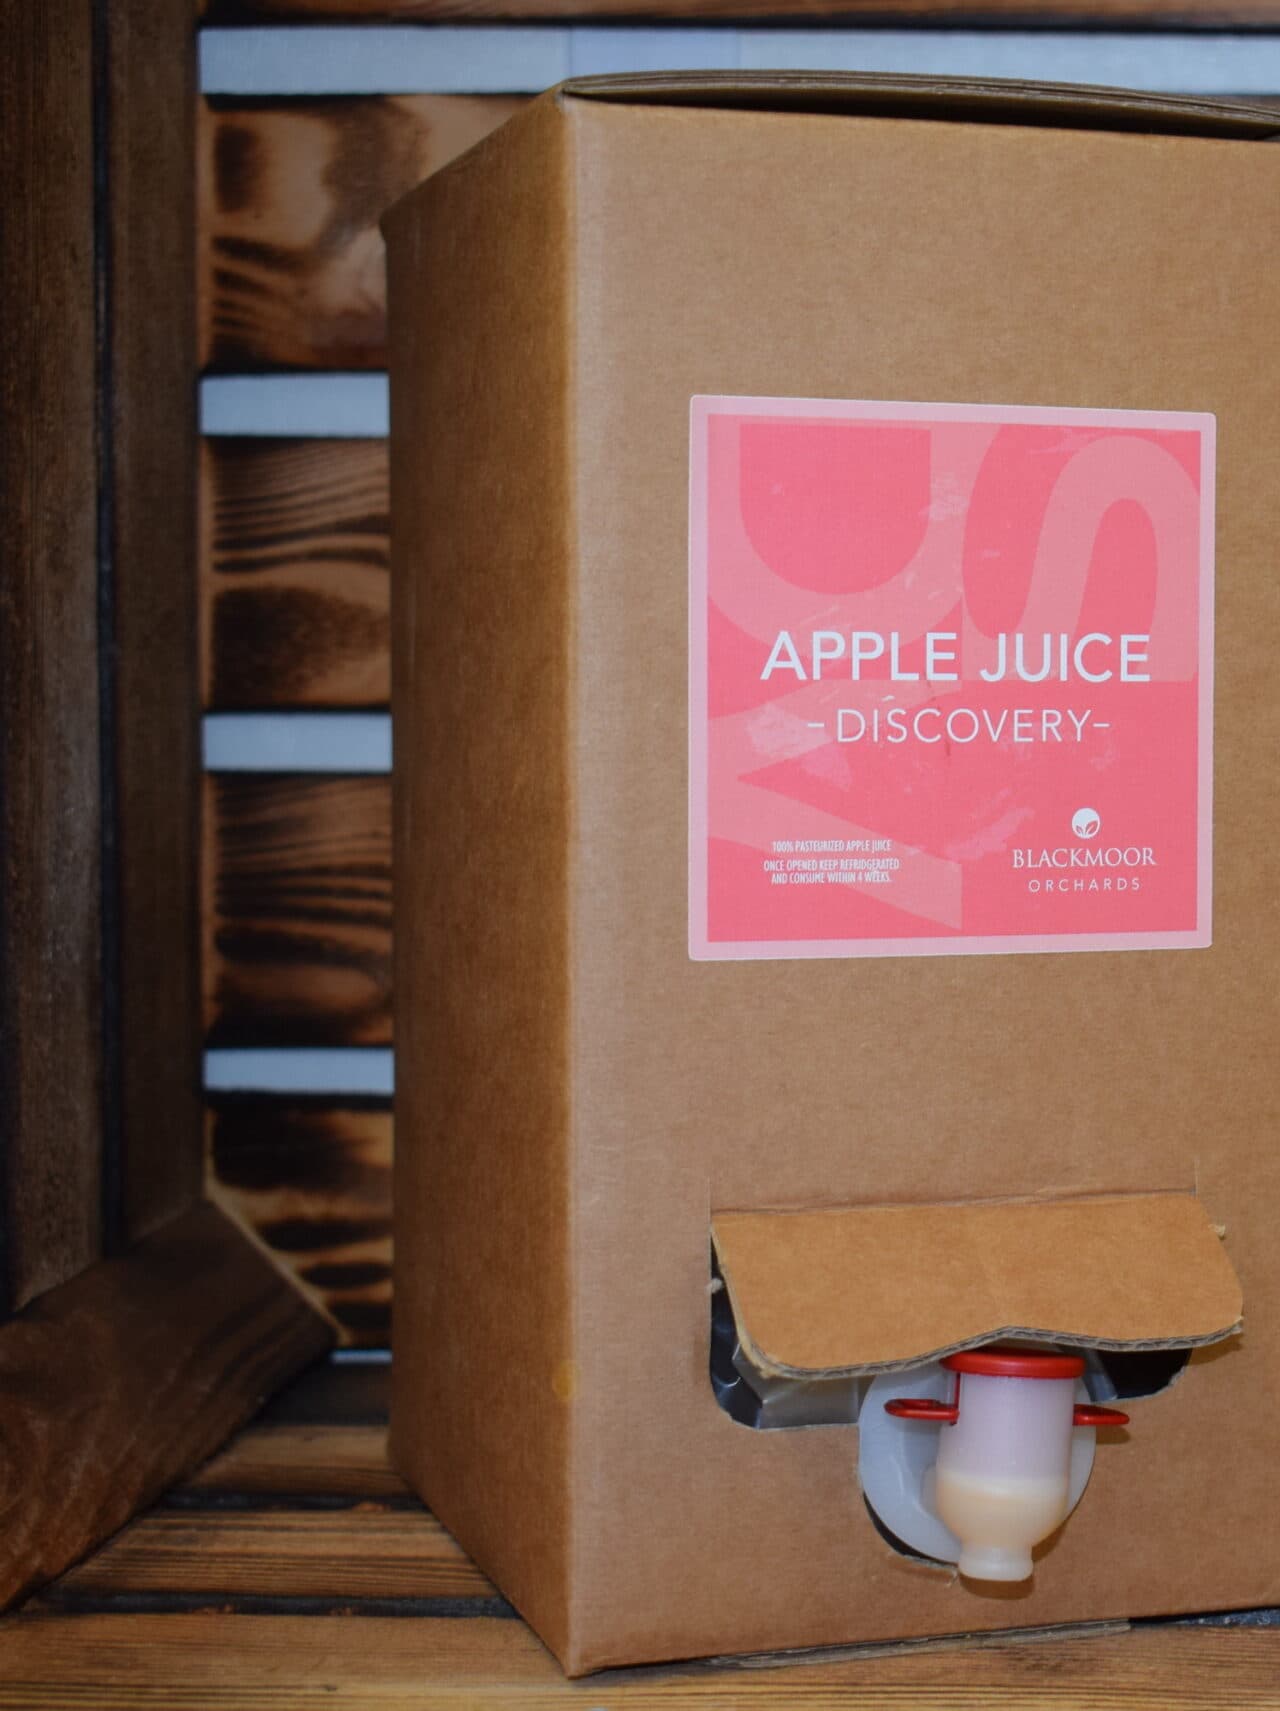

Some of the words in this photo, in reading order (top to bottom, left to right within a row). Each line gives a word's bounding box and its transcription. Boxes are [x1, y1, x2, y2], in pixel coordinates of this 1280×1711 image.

[759, 631, 959, 681] APPLE
[979, 632, 1152, 682] JUICE
[772, 841, 793, 853] 100%
[846, 839, 870, 851] APPLE
[872, 839, 893, 853] JUICE
[1012, 847, 1157, 868] BLACKMOOR
[763, 859, 785, 872] ONCE
[786, 859, 818, 872] OPENED
[819, 859, 838, 871] KEEP
[771, 872, 788, 885] AND
[789, 872, 825, 884] CONSUME
[827, 871, 856, 883] WITHIN
[1028, 878, 1141, 893] ORCHARDS
